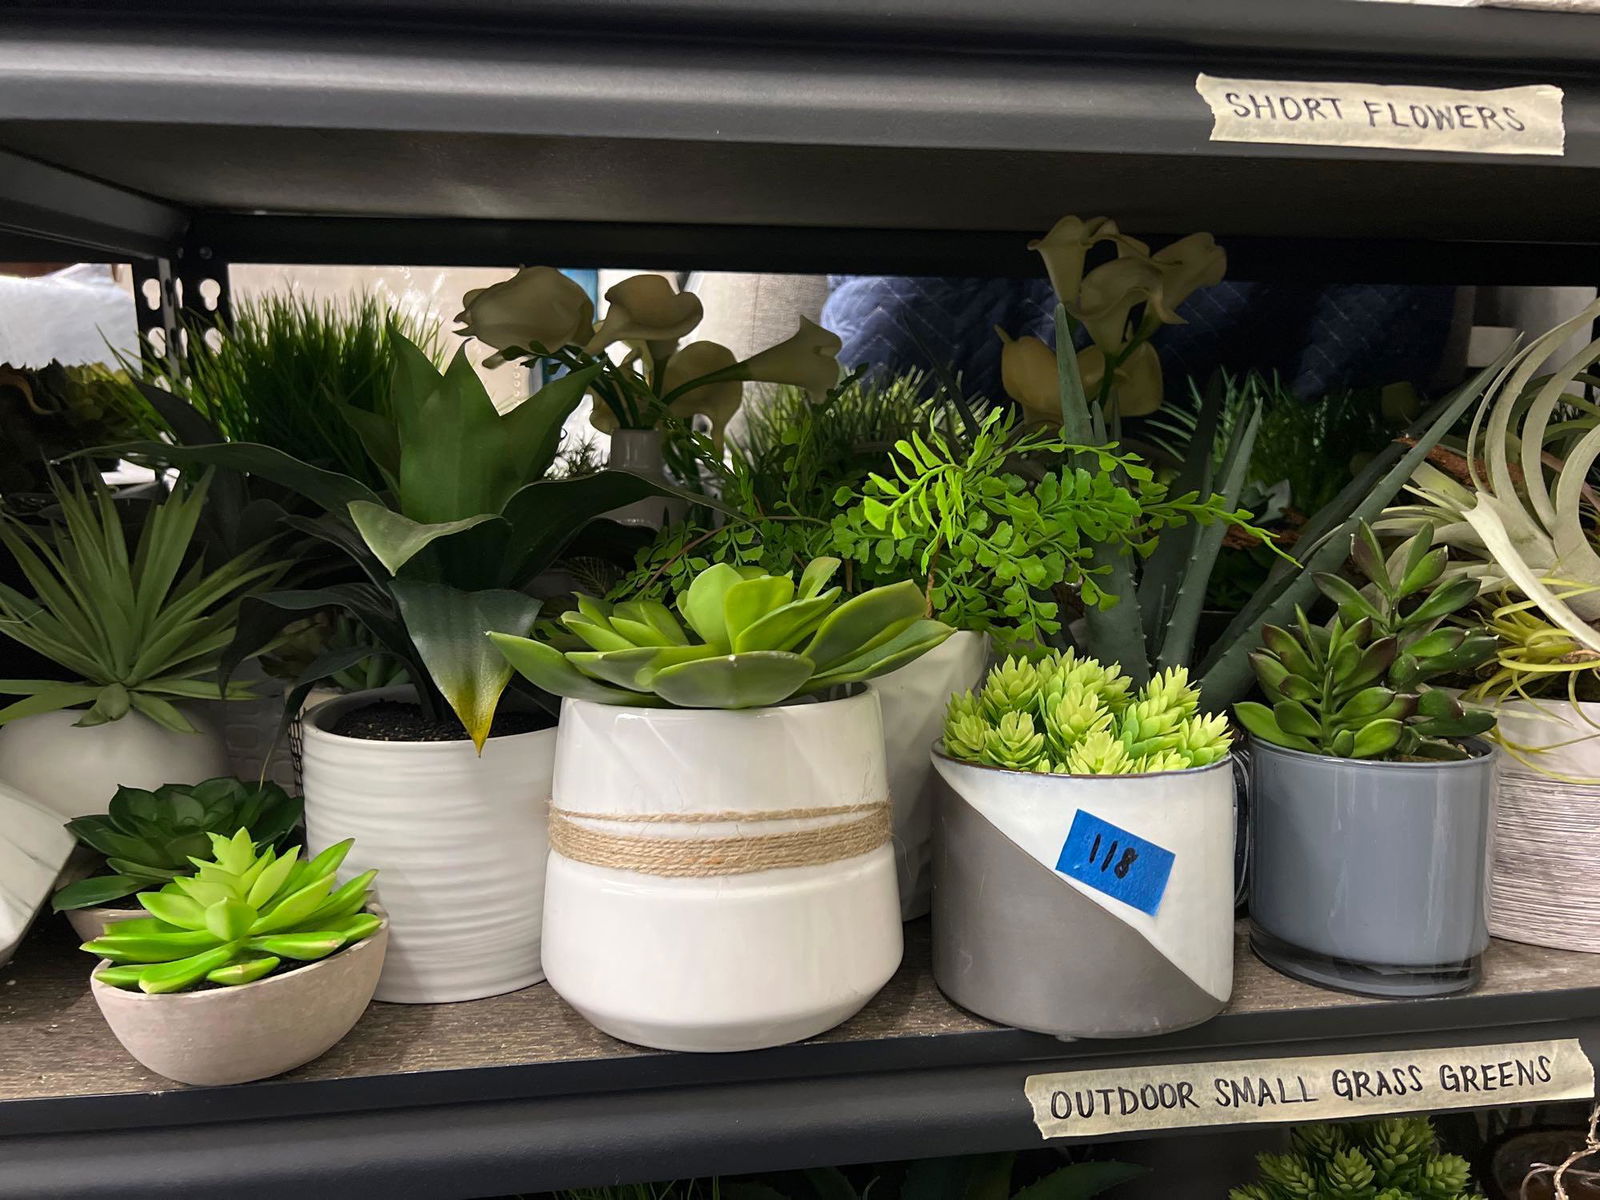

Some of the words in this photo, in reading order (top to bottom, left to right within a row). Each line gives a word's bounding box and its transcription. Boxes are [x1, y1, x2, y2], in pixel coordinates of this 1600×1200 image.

[1226, 92, 1343, 121] SHORT
[1364, 100, 1525, 132] FLOWERS
[1089, 833, 1138, 879] 118
[1050, 1081, 1200, 1120] OUTDOOR
[1214, 1076, 1319, 1108] SMALL
[1331, 1067, 1423, 1098] GRASS
[1439, 1055, 1552, 1093] GREENS
